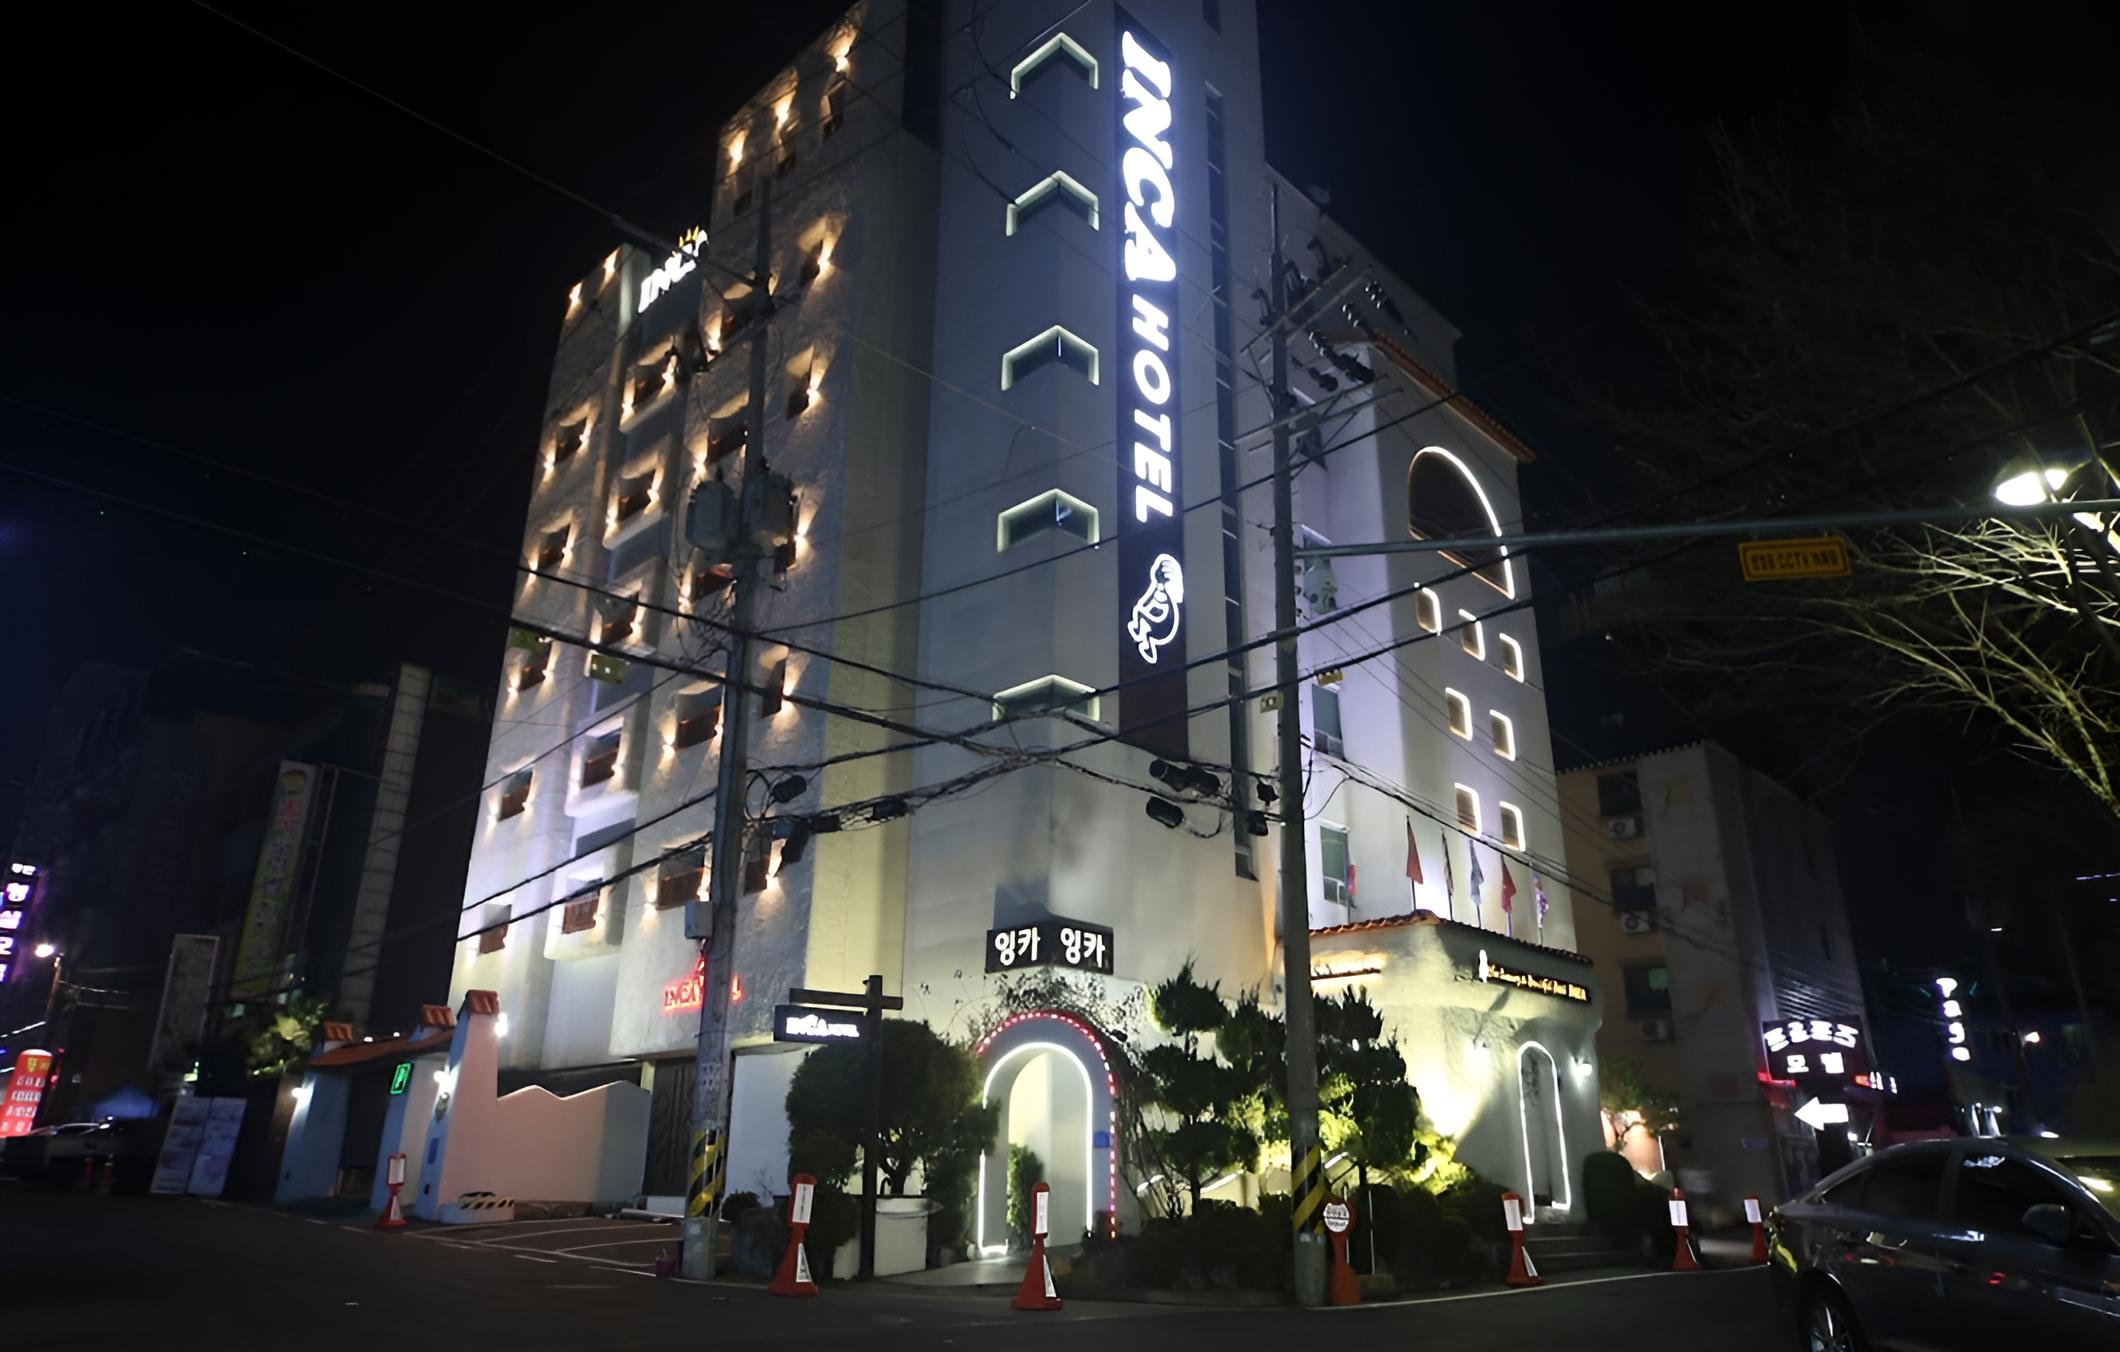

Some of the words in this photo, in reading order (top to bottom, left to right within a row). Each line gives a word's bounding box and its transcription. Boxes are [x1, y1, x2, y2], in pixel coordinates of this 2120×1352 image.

[1121, 30, 1177, 283] INCA
[1132, 294, 1175, 524] HOTEL
[994, 926, 1041, 966] 잉카
[1060, 926, 1106, 968] 잉카
